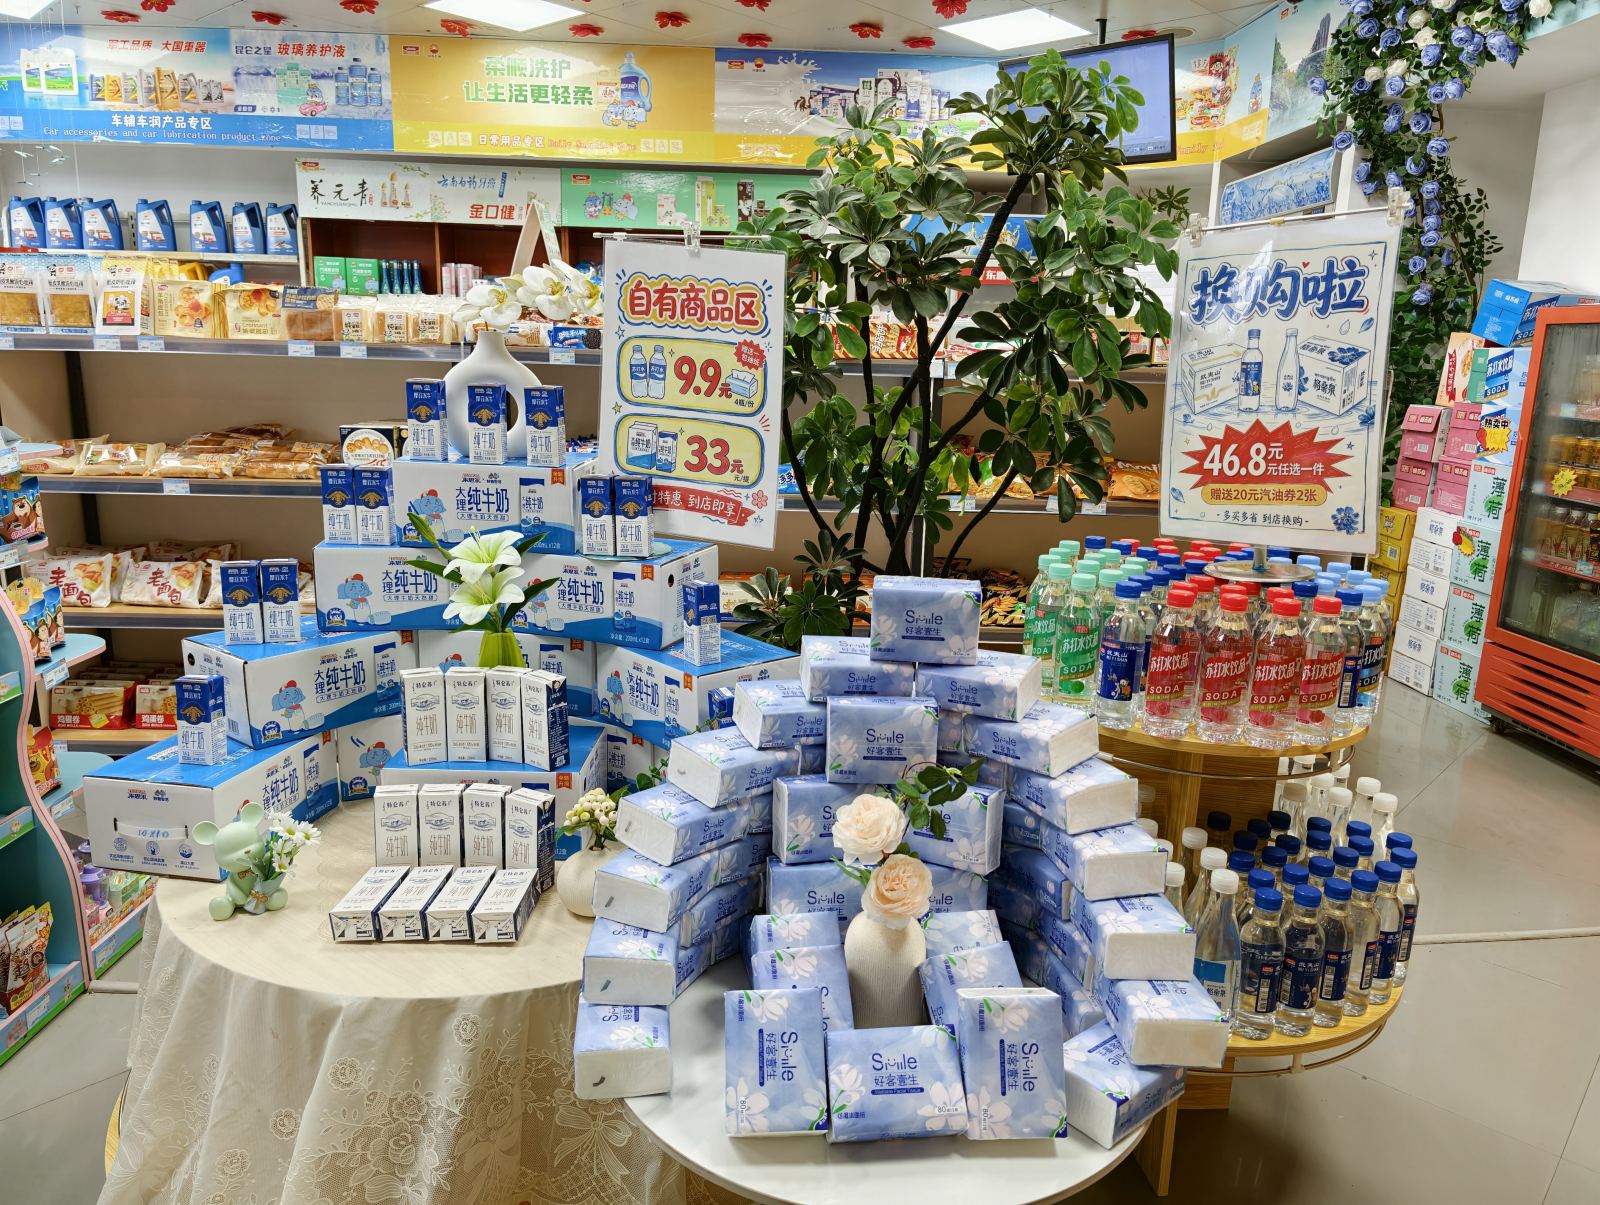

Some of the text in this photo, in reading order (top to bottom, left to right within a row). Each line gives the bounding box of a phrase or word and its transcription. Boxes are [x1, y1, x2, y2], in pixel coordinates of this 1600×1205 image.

[161, 41, 207, 53] 大国重器
[277, 43, 345, 57] 玻璃养护液
[484, 56, 571, 78] 柔顺洗护
[464, 81, 593, 105] 让生活更轻柔
[111, 114, 212, 130] 车辅车润产品专区
[44, 127, 58, 135] Car
[63, 129, 118, 137] accessories
[163, 130, 217, 140] lubrication
[479, 135, 545, 148] 日常用品专区
[469, 203, 516, 220] 金口健
[1190, 259, 1367, 322] 换购啦
[629, 280, 759, 326] 自有商品区
[674, 356, 733, 398] 9.9 元
[1486, 383, 1506, 396] SODA
[1484, 418, 1509, 429] 热卖中
[684, 435, 744, 475] 33 元
[1203, 442, 1284, 478] 46.8 元
[1267, 462, 1325, 477] 元任选一件
[468, 486, 510, 513] 纯牛奶
[688, 494, 737, 517] 到店即享
[1210, 488, 1317, 503] 赠送20元汽油券2张
[1488, 476, 1508, 520] 薄荷
[1223, 510, 1303, 527] 多买多省 到店换购
[1472, 539, 1492, 583] 薄荷
[50, 566, 92, 607] 老面包
[148, 568, 183, 605] 老面包
[394, 569, 438, 593] 纯牛奶
[567, 578, 605, 606] 纯牛奶
[905, 609, 944, 625] Smile
[1466, 602, 1486, 645] 薄荷
[1062, 632, 1098, 653] 苏打水饮品
[1063, 664, 1092, 674] SODA
[1150, 652, 1189, 672] 苏打水饮品
[1206, 658, 1246, 679] 苏打水饮品
[1255, 662, 1295, 682] 苏打水饮品
[1302, 659, 1342, 680] 苏打水饮品
[325, 660, 366, 691] 纯牛奶
[1455, 661, 1473, 704] 薄荷
[636, 673, 659, 708] 纯牛奶
[1150, 684, 1180, 694] SODA
[1205, 691, 1237, 701] SODA
[1301, 692, 1334, 703] SODA
[1253, 695, 1285, 704] SODA
[57, 715, 81, 724] 鸡蛋卷
[141, 714, 165, 724] 鸡蛋卷
[866, 728, 905, 744] Smile
[270, 768, 299, 806] 纯牛奶
[808, 890, 845, 905] Smile
[781, 1031, 799, 1082] Smile
[872, 1053, 918, 1071] Smile
[1022, 1042, 1039, 1092] Smile
[874, 1074, 919, 1087] 好客壹生
